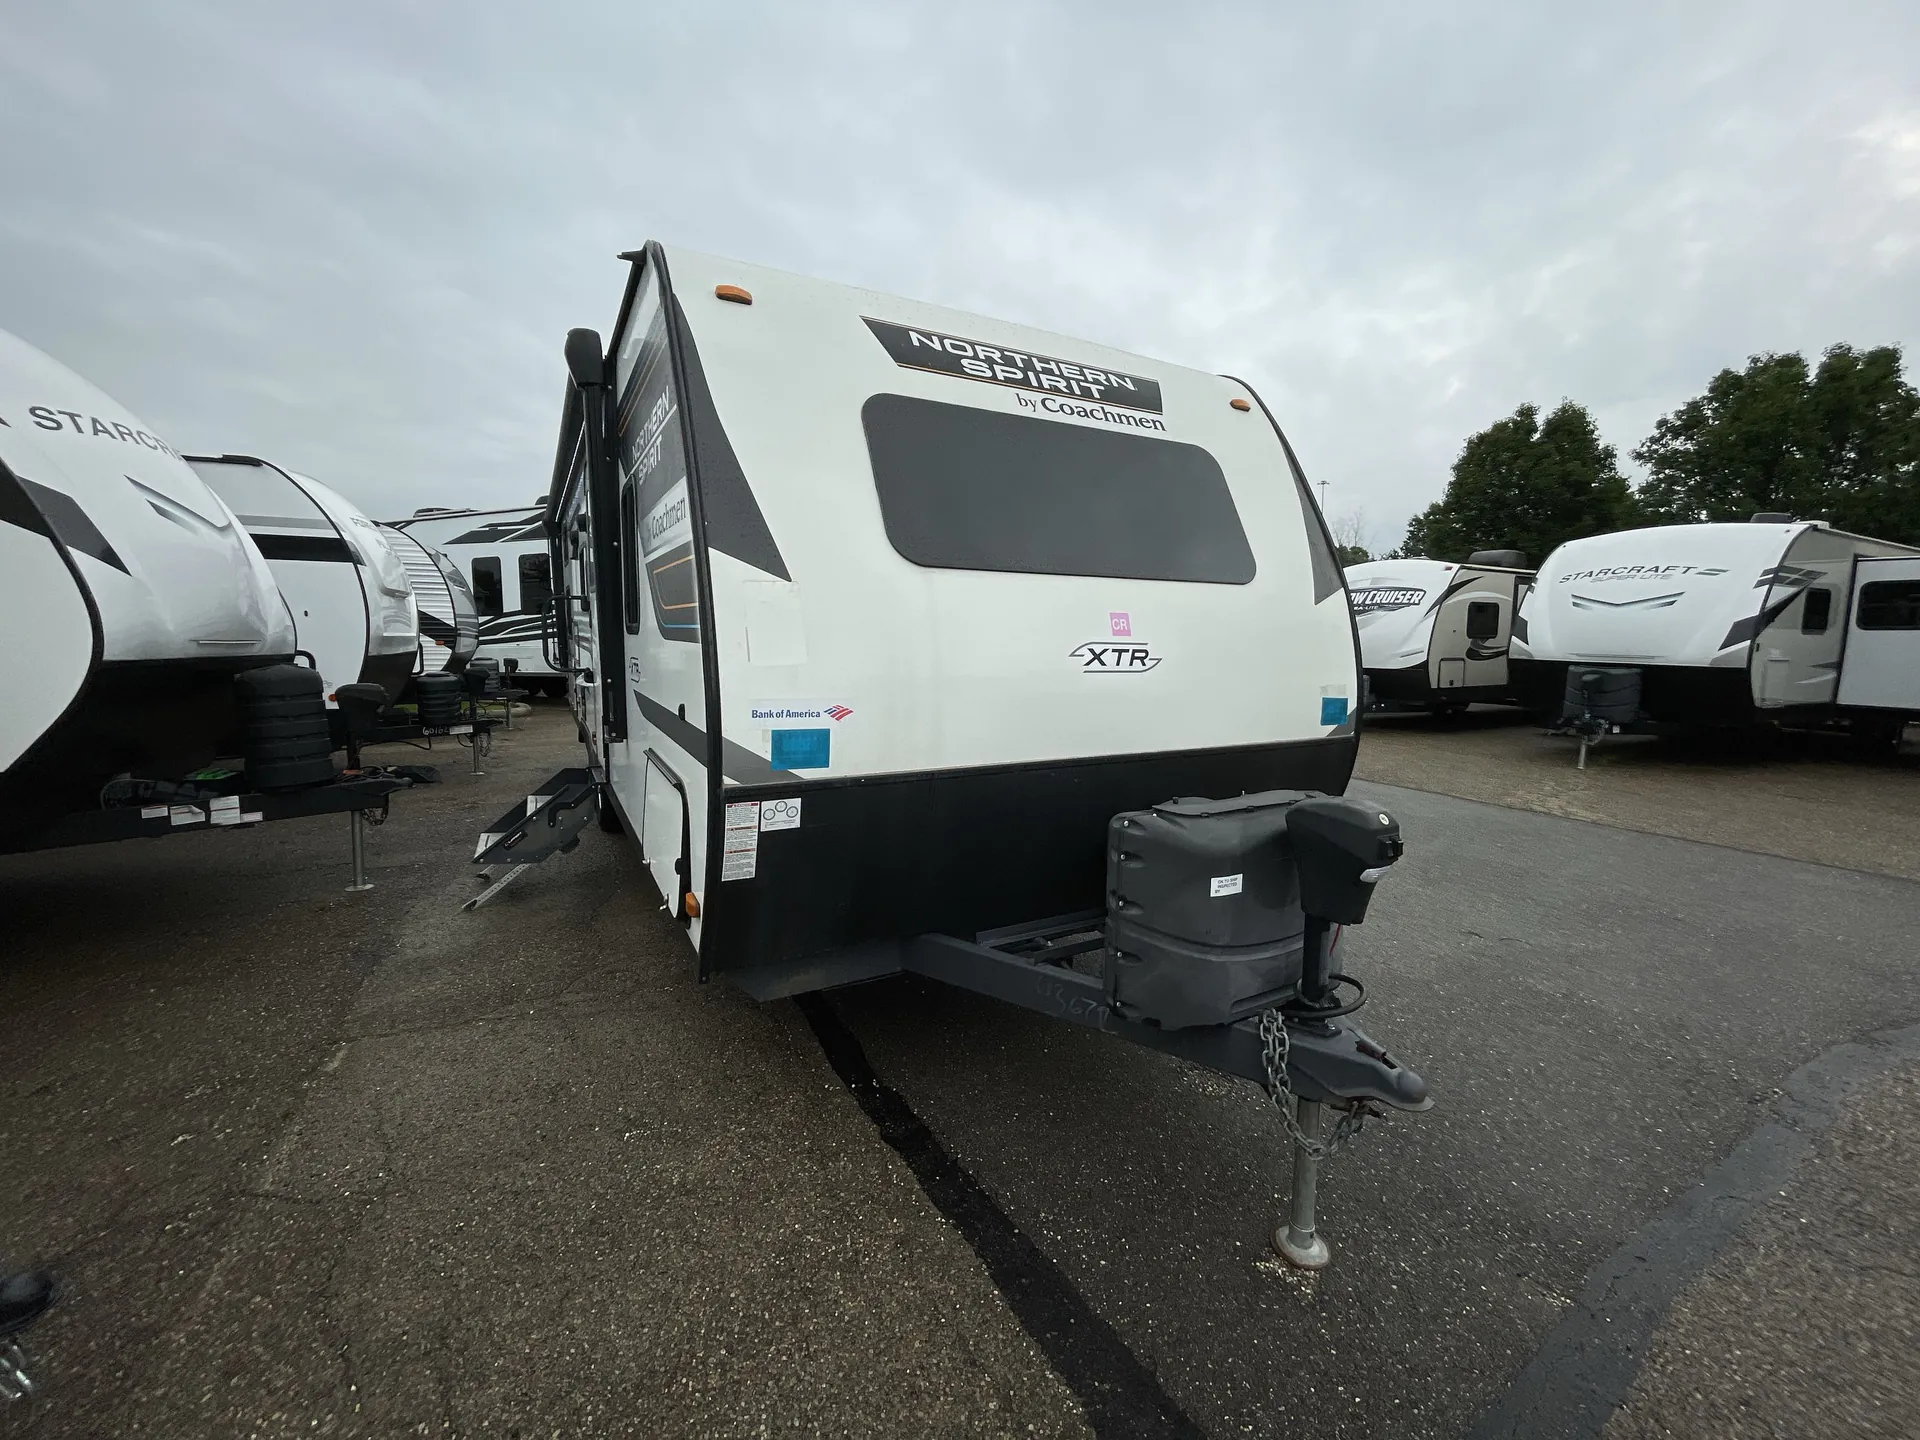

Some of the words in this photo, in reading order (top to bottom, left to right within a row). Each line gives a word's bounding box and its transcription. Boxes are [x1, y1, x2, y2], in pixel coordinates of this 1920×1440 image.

[908, 331, 1136, 391] NORTHERN
[960, 358, 1105, 398] SPIRIT
[632, 385, 669, 464] NORTHERN
[1015, 393, 1037, 412] by
[1041, 397, 1166, 431] Coachmen
[638, 434, 662, 486] SPIRIT
[651, 497, 687, 540] Coachmen
[1559, 565, 1698, 584] STARCRAFT
[1365, 590, 1425, 604] CRUISER
[1112, 618, 1128, 631] CR
[1083, 647, 1149, 667] XTR
[751, 709, 775, 719] Bank
[775, 709, 784, 719] of
[785, 709, 821, 718] America
